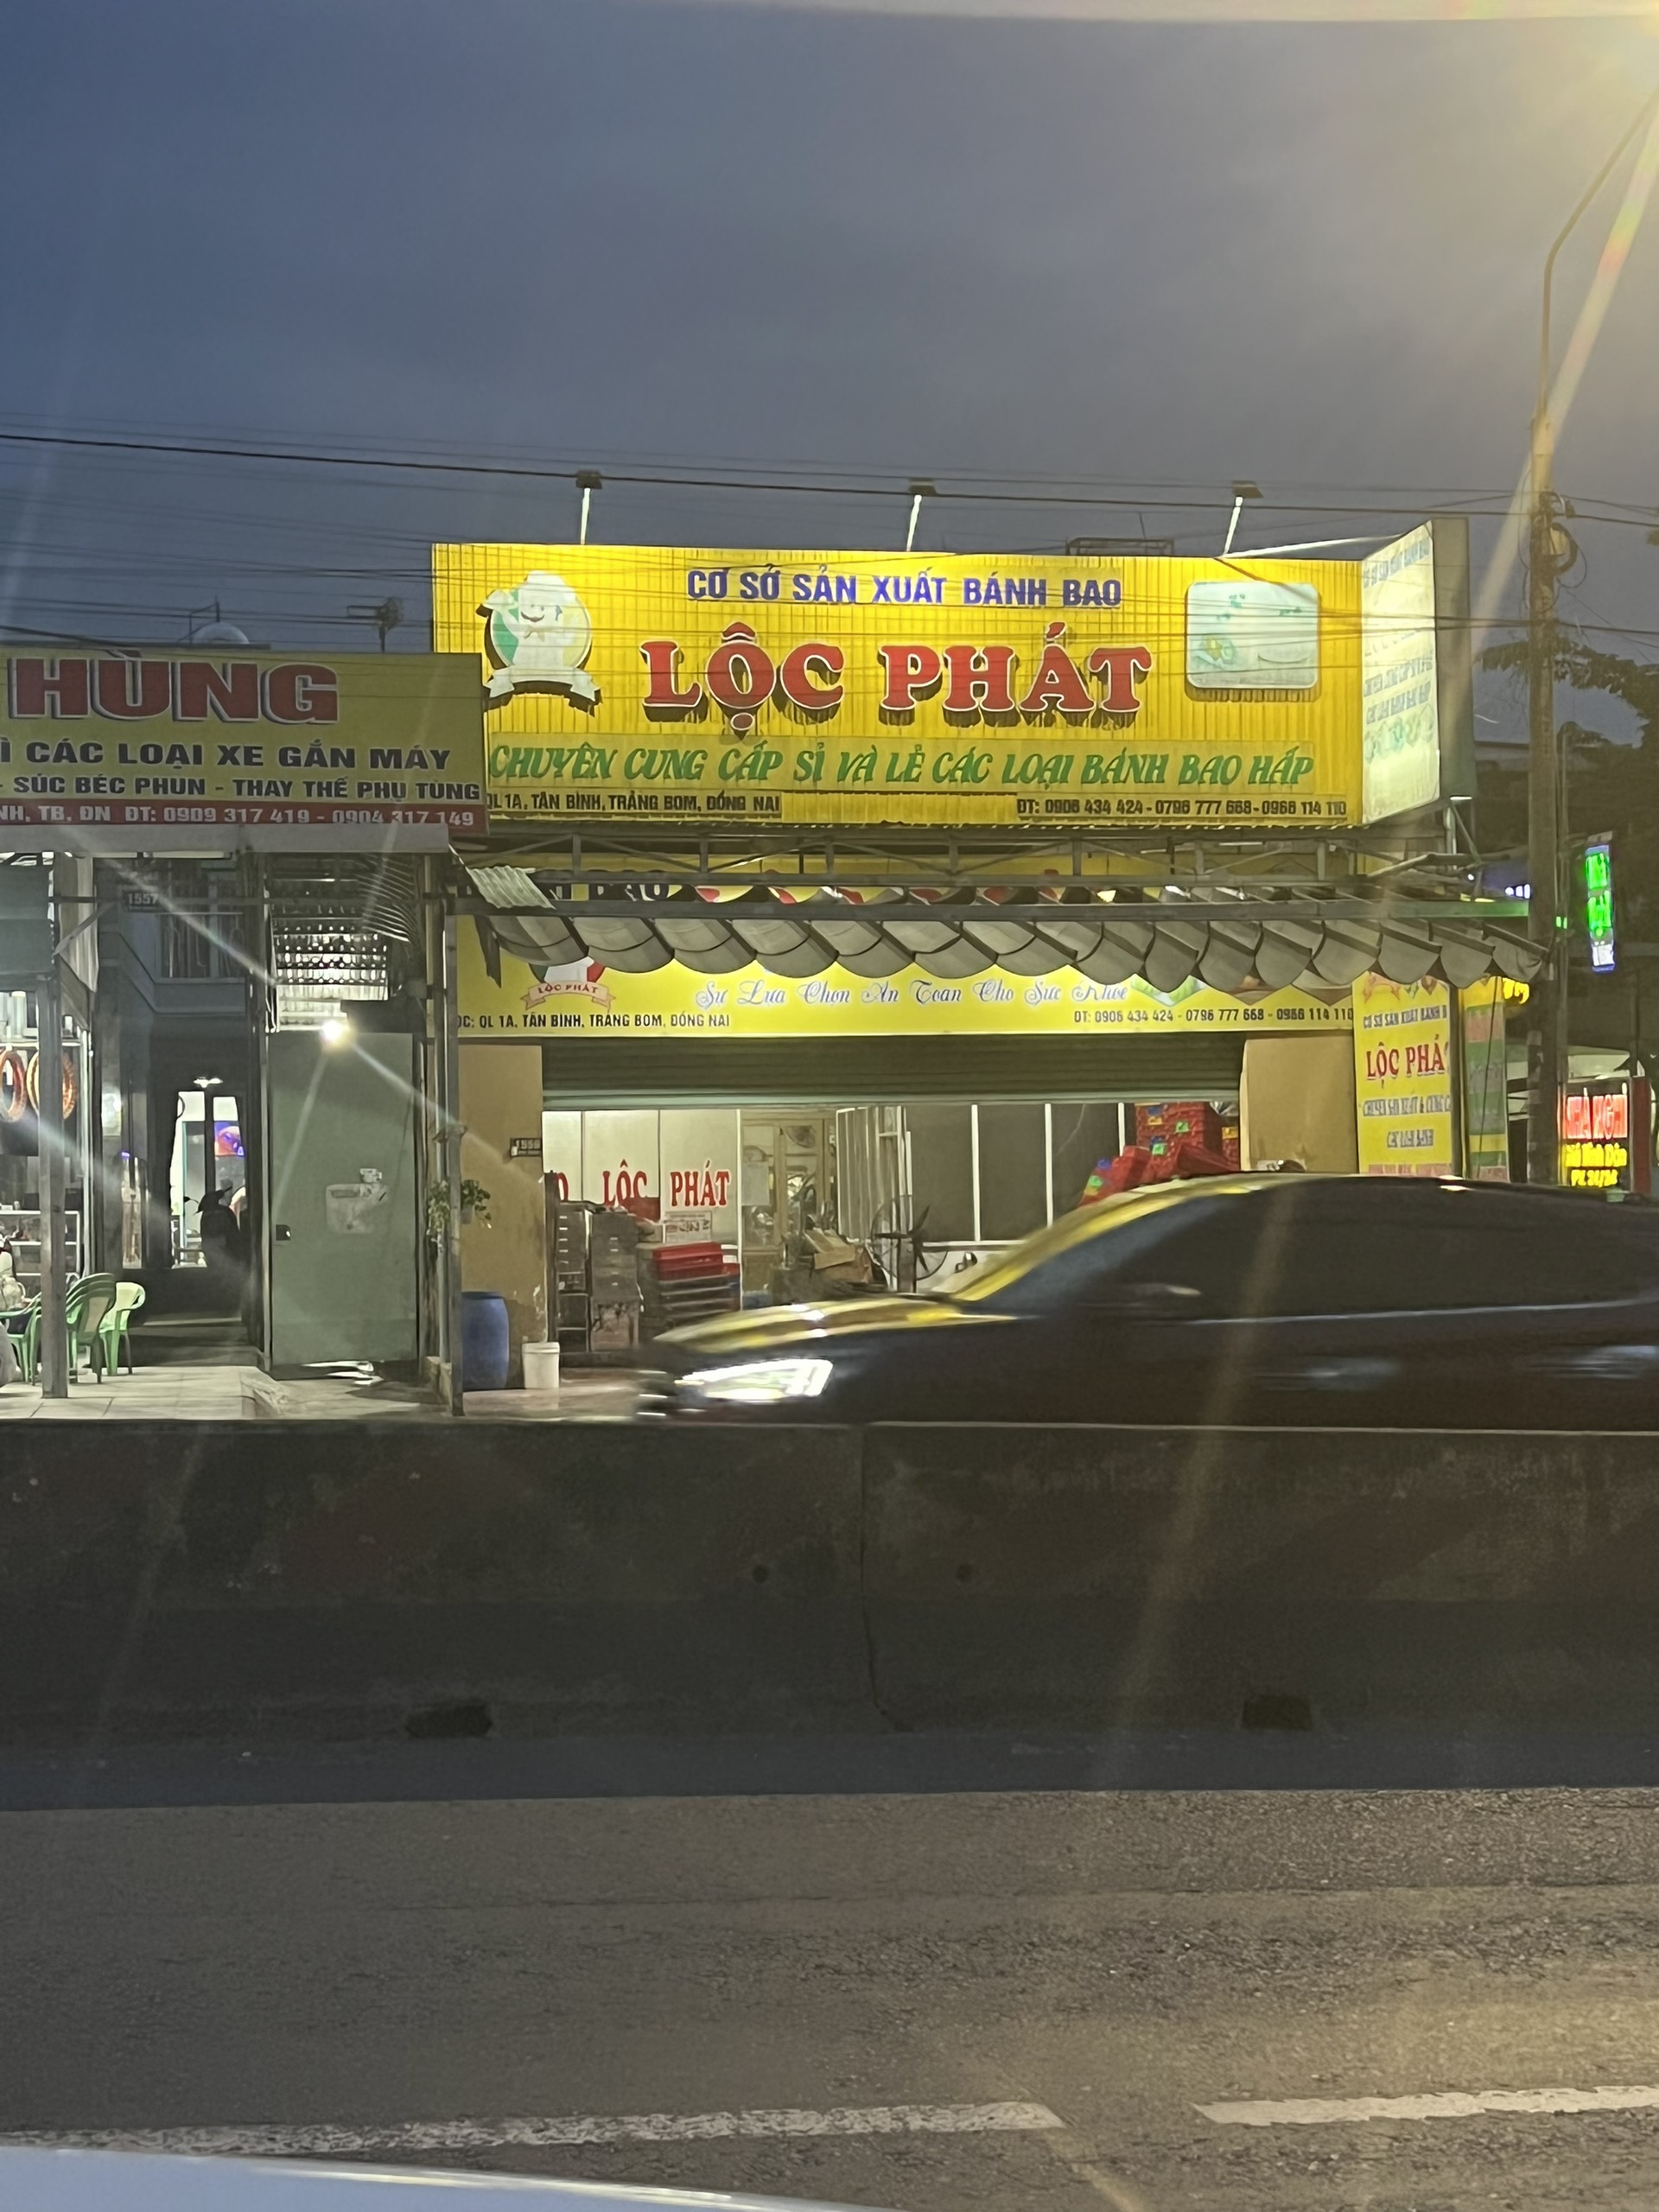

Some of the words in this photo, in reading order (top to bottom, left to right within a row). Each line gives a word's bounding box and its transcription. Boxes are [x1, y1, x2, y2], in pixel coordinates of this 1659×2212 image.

[688, 568, 730, 600] CƠ
[740, 563, 781, 601] SỞ
[792, 564, 856, 603] SẢN
[872, 566, 947, 604] XUẤT
[963, 571, 1047, 607] BÁNH
[1063, 579, 1122, 607] BAO
[9, 649, 339, 723] HÙNG
[639, 621, 845, 731] LỘC
[878, 621, 1153, 713] PHÁT
[27, 738, 104, 764] CÁC
[118, 743, 203, 770] LOẠI
[217, 745, 264, 766] XE
[278, 739, 356, 769] GẮN
[370, 745, 451, 770] MÁY
[491, 741, 619, 779] CHUYÊN
[624, 748, 709, 780] CUNG
[718, 740, 784, 781] CẤP
[793, 742, 825, 783] SỈ
[837, 745, 878, 783] VÀ
[886, 744, 925, 783] LẺ
[932, 747, 993, 784] CÁC
[1001, 754, 1075, 790] LOẠI
[1081, 747, 1170, 785] BÁNH
[1179, 754, 1243, 785] BAO
[1248, 746, 1314, 785] HẤP
[14, 773, 66, 794] SÚC
[75, 774, 125, 795] BÉC
[135, 779, 206, 796] PHUN
[232, 779, 293, 798] THAY
[416, 779, 480, 800] TÙNG
[163, 807, 216, 822] 0909
[224, 808, 260, 823] 317
[270, 810, 309, 823] 419
[753, 795, 780, 812] NAI
[1084, 799, 1112, 815] 434
[1116, 799, 1143, 815] 424
[1195, 800, 1223, 815] 777
[1300, 801, 1322, 816] 114
[972, 978, 1014, 1002] Cho
[709, 1014, 730, 1027] NAI
[1127, 1009, 1148, 1022] 434
[1152, 1009, 1174, 1022] 424
[1218, 1008, 1240, 1021] 777
[1366, 1040, 1400, 1089] LỘC
[1405, 1033, 1449, 1075] PHÁ
[670, 1160, 730, 1207] PHÁT
